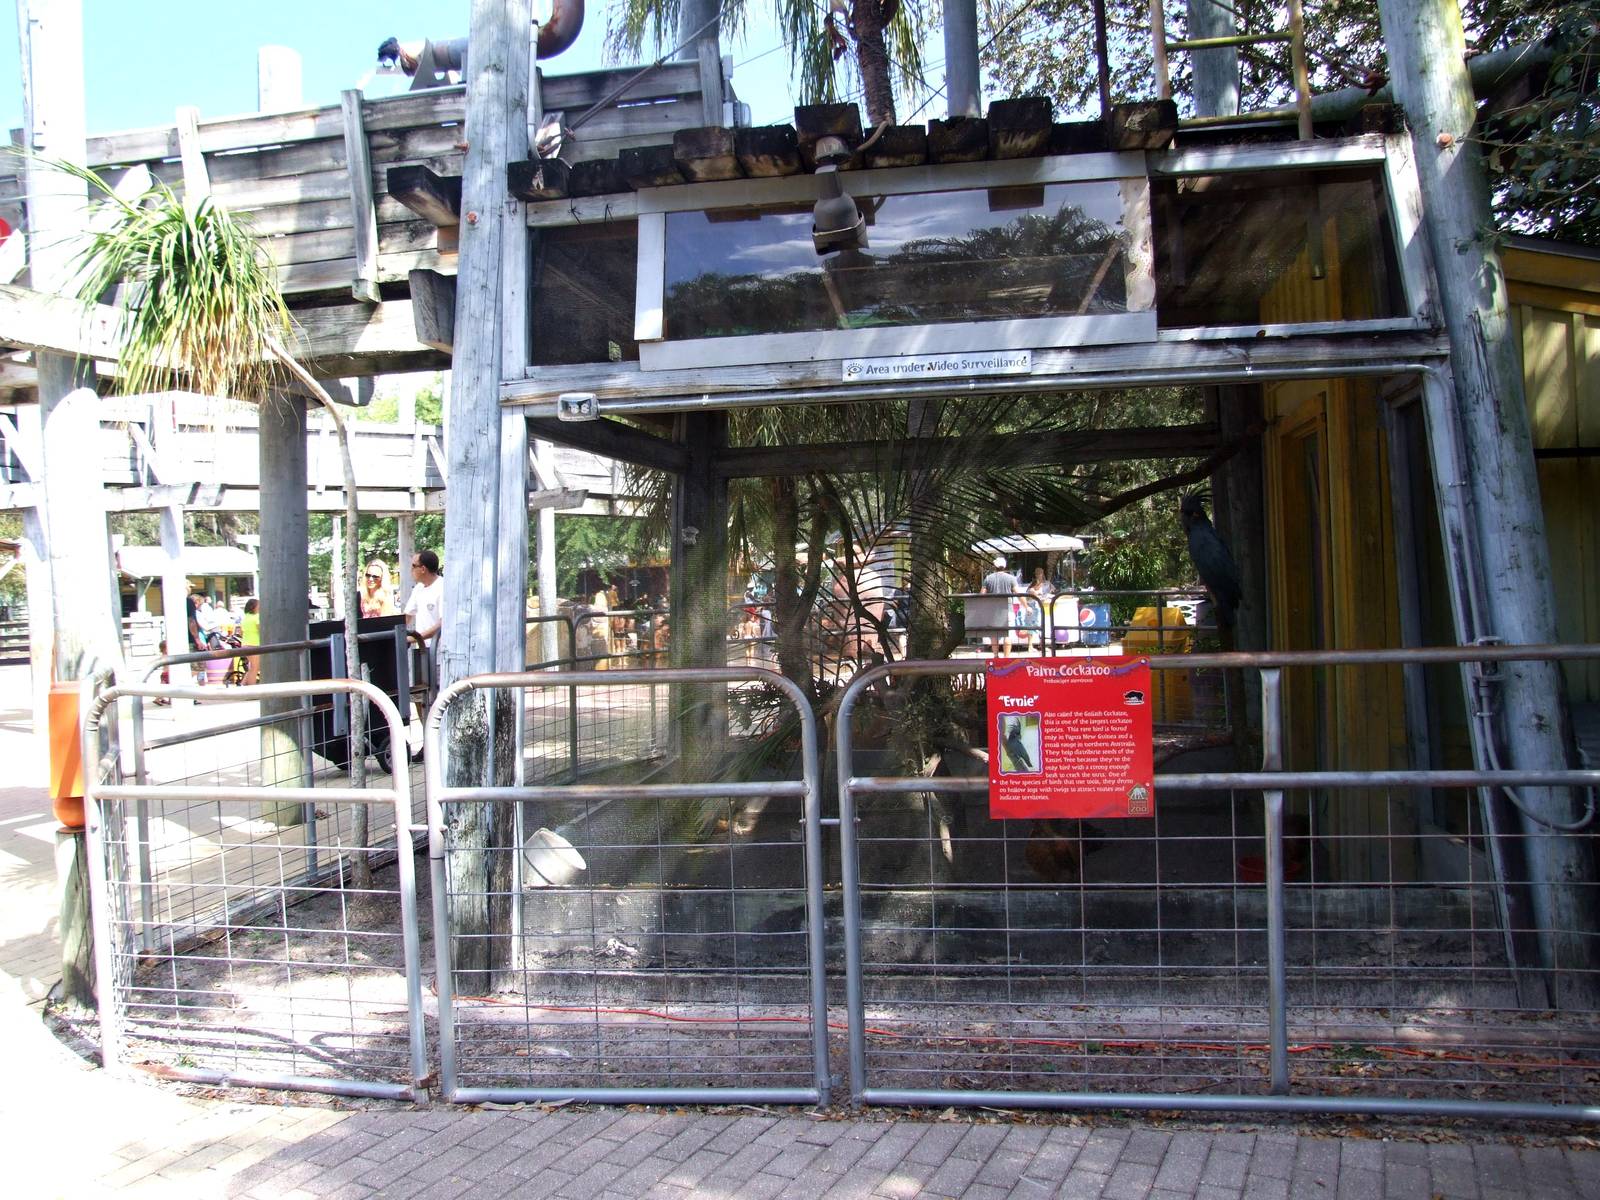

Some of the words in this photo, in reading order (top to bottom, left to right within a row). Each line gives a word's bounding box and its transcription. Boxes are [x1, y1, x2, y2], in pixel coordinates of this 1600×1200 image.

[866, 364, 890, 374] Area
[893, 363, 925, 373] under
[928, 362, 959, 372] Video
[962, 358, 1027, 369] Surveillance
[1027, 666, 1055, 677] Palm
[1060, 665, 1110, 676] Cockatoo
